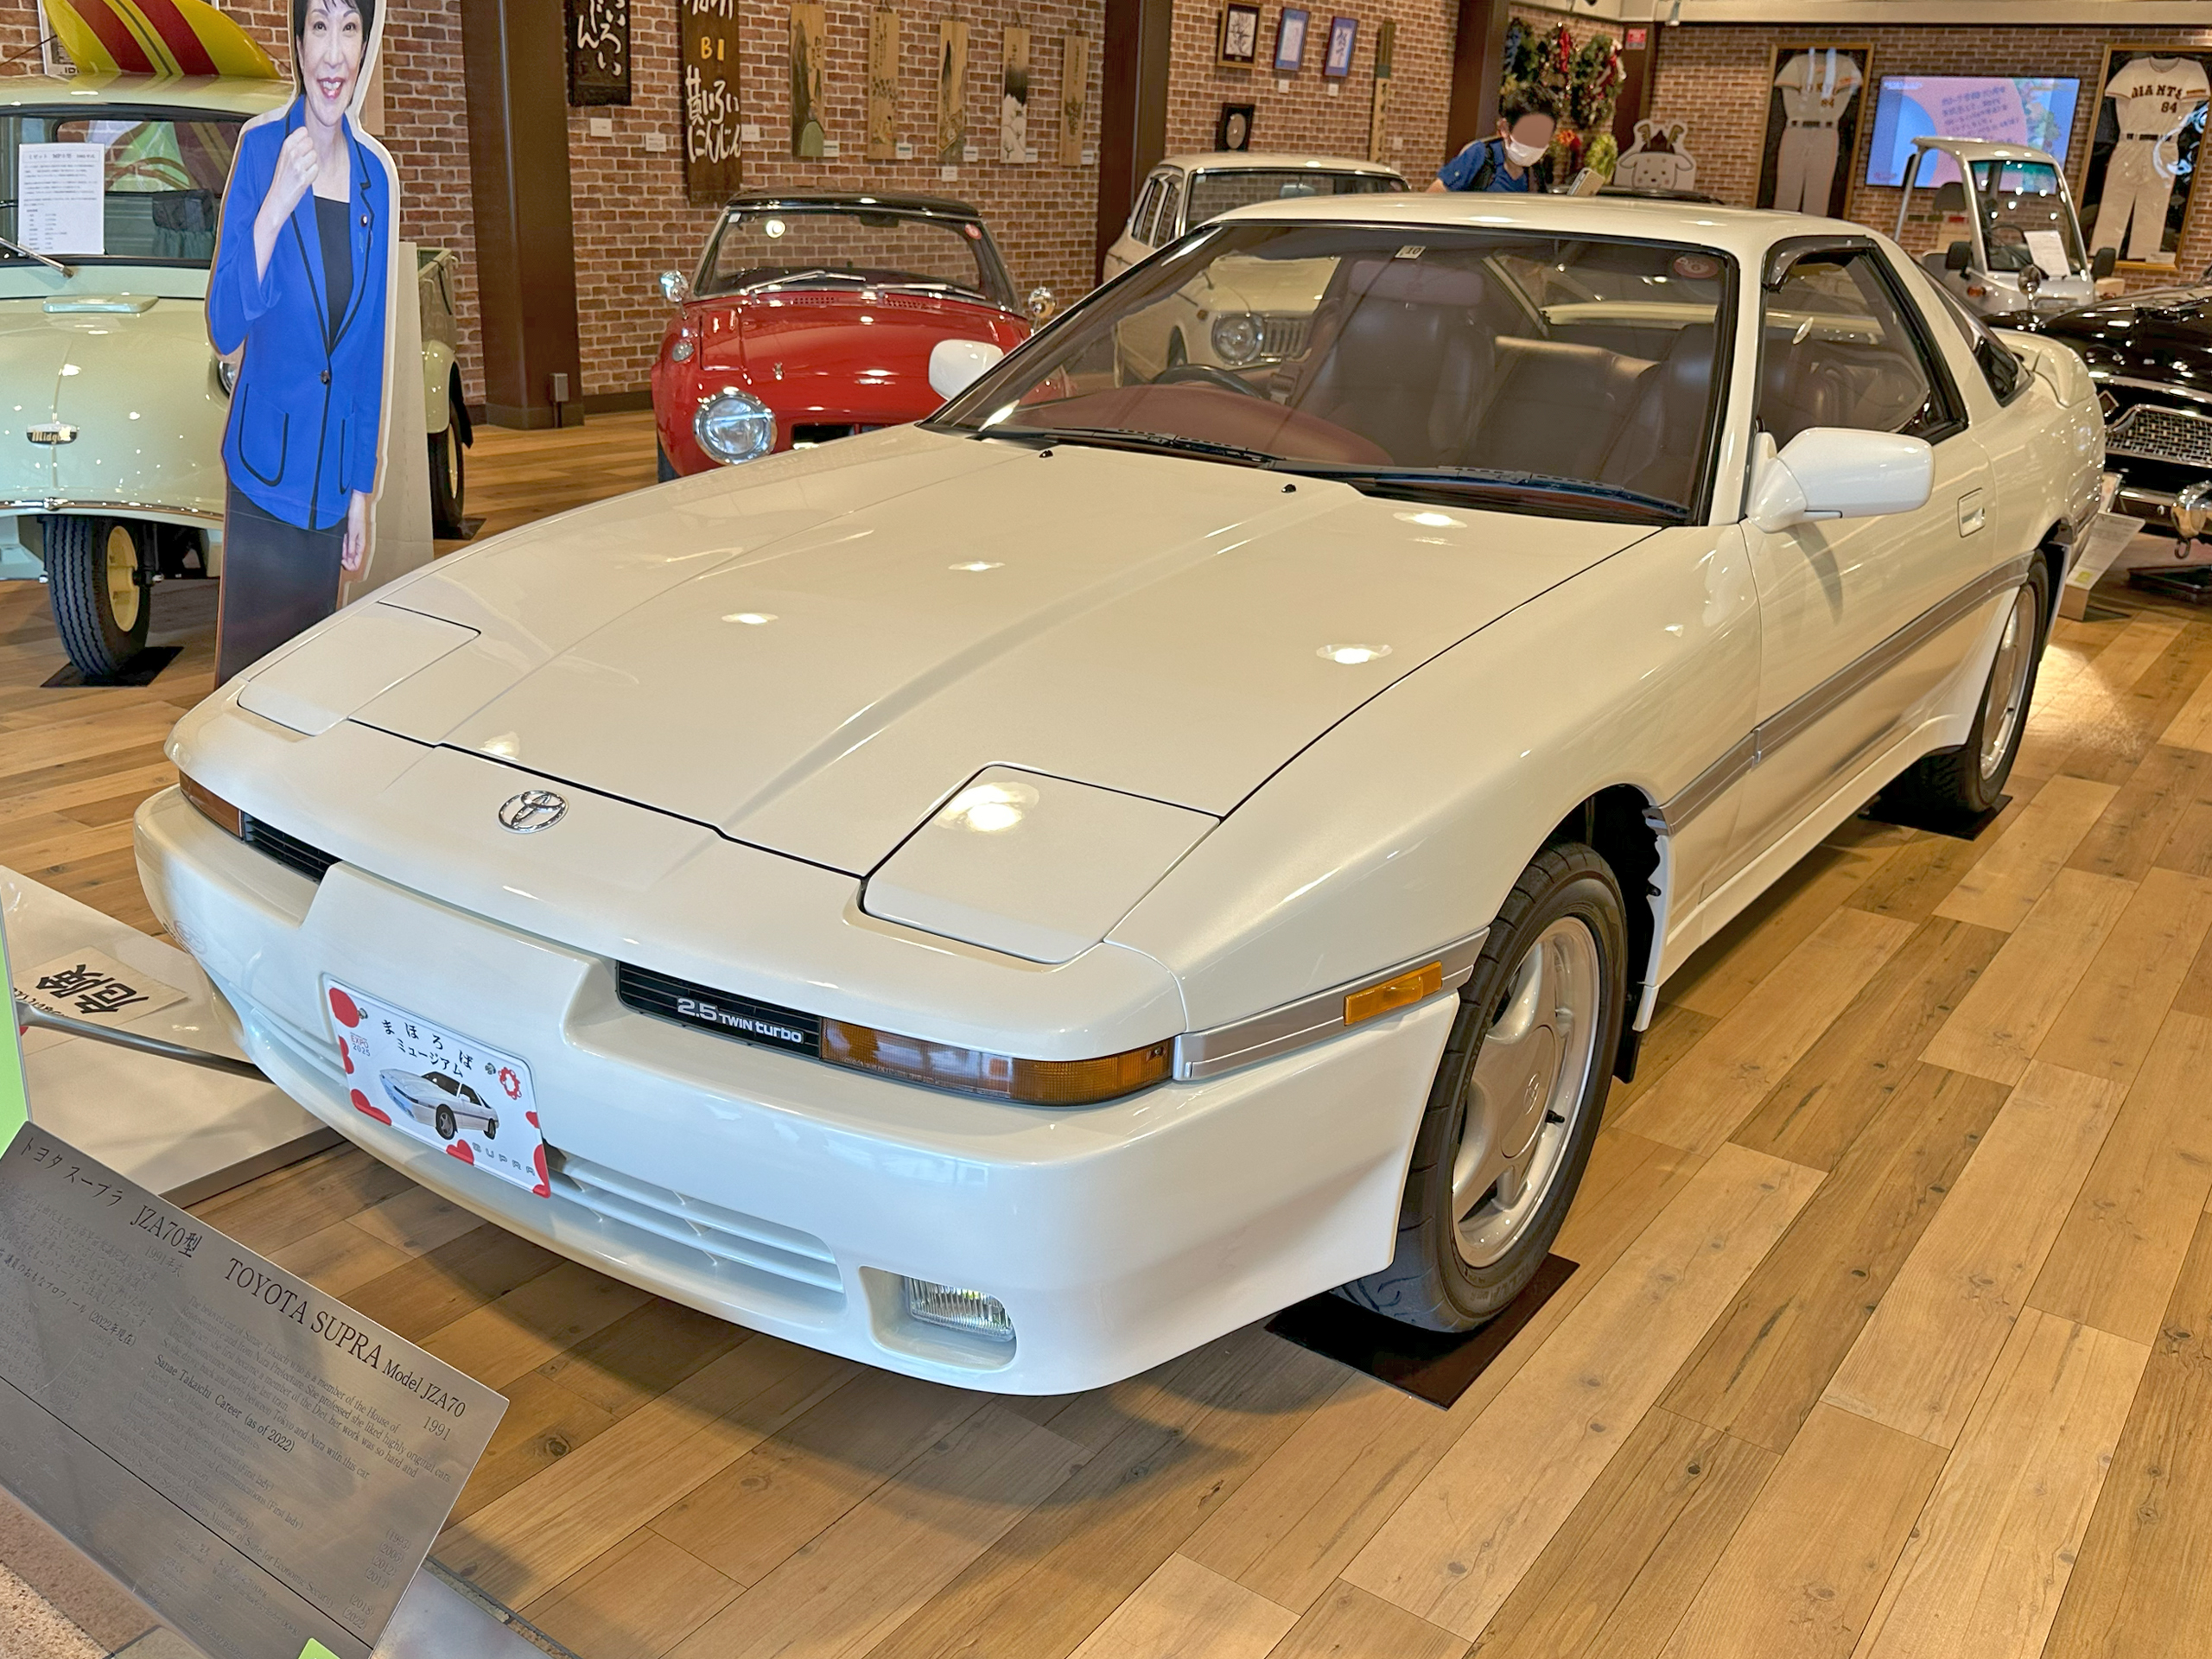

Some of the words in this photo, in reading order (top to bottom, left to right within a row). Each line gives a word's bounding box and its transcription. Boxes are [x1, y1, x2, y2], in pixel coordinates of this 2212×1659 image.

[2161, 102, 2178, 113] 84
[32, 429, 71, 444] Midg
[677, 997, 717, 1022] 2.5
[718, 1012, 753, 1032] TWIN
[755, 1020, 803, 1043] turbo
[353, 1042, 371, 1057] 2025
[381, 1020, 473, 1071] まほろば
[397, 1038, 464, 1077] ミュージアム
[472, 1141, 536, 1177] SUPRA
[21, 1138, 63, 1173] トヨタ
[62, 1163, 124, 1210] スープラ
[130, 1204, 202, 1258] JZA70型
[222, 1258, 312, 1323] TOYOTA
[310, 1311, 387, 1368] SUPRA
[382, 1359, 423, 1391] Model
[421, 1382, 467, 1419] JZA70
[154, 1353, 180, 1376] Sanae
[177, 1369, 213, 1399] Takaichi
[213, 1393, 244, 1419] Career
[244, 1413, 259, 1429] (as
[257, 1421, 270, 1436] of
[267, 1427, 296, 1452] 2022)
[264, 1374, 293, 1397] member
[299, 1396, 313, 1410] the
[328, 1414, 343, 1429] her
[341, 1423, 361, 1441] work
[360, 1435, 377, 1451] was
[374, 1444, 386, 1457] so
[385, 1451, 404, 1468] hard
[402, 1461, 418, 1478] and
[304, 1384, 321, 1400] She
[318, 1393, 352, 1420] professed
[350, 1413, 365, 1427] she
[364, 1421, 383, 1440] liked
[382, 1433, 407, 1454] highly
[317, 1376, 346, 1400] member
[345, 1393, 356, 1405] of
[353, 1398, 368, 1413] the
[366, 1407, 391, 1427] House
[389, 1421, 401, 1433] of
[270, 1409, 296, 1431] Tokyo
[294, 1424, 309, 1440] and
[308, 1433, 327, 1451] Nara
[325, 1445, 344, 1463] with
[342, 1456, 359, 1471] this
[422, 1415, 452, 1440] 1991
[341, 1606, 368, 1630] (2022)
